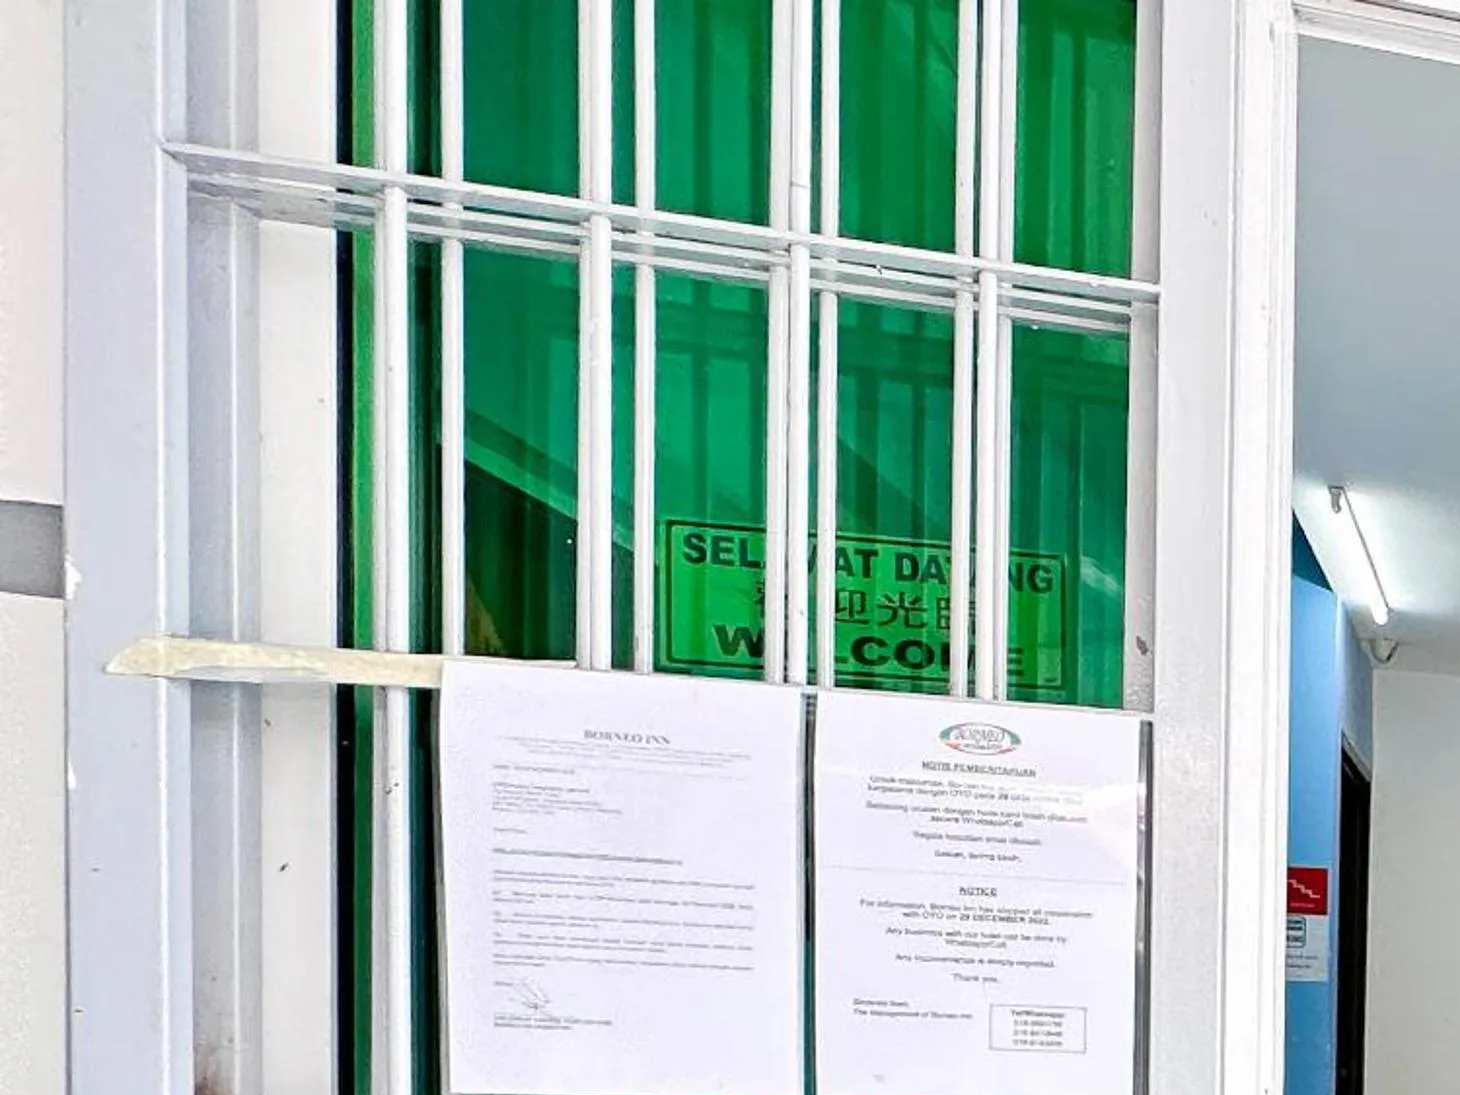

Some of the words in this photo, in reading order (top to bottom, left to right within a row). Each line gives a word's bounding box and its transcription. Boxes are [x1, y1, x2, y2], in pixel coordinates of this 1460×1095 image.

[683, 532, 879, 580] SELAT
[894, 551, 1054, 594] DANG
[583, 729, 644, 744] BORNEO
